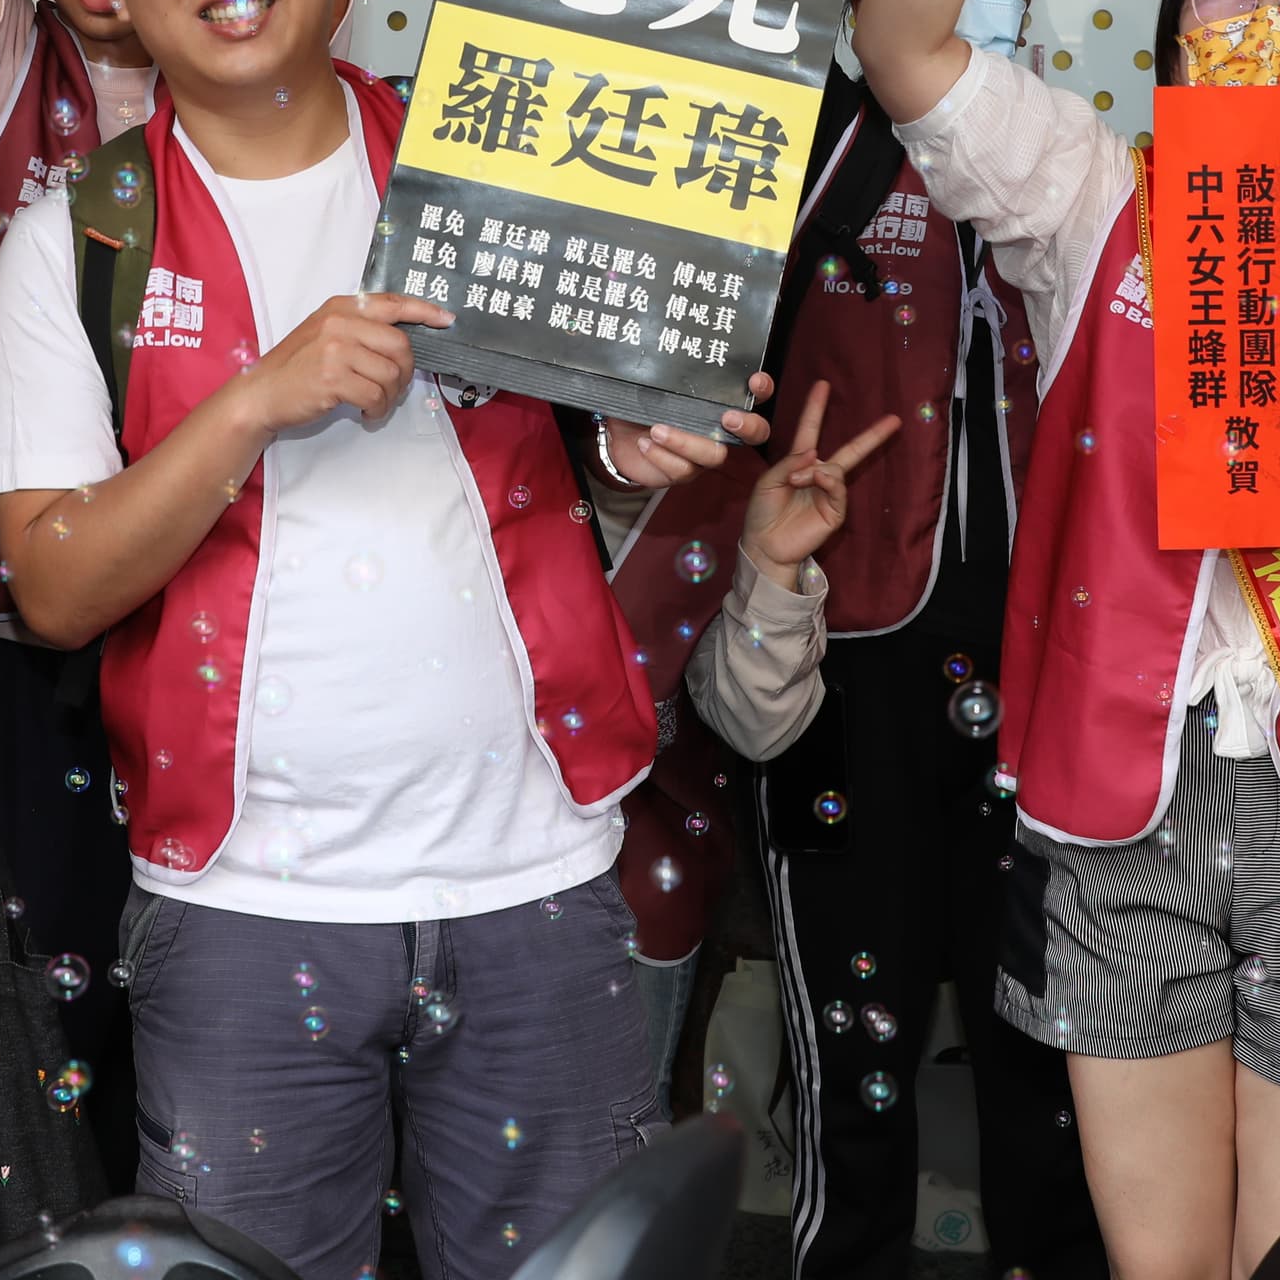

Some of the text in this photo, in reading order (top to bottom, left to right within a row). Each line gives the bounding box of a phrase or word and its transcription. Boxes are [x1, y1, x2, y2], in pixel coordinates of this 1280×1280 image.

[431, 41, 791, 212] 羅廷瑋
[145, 267, 203, 304] 東南
[410, 236, 737, 335] 罷免 廖偉翔 就是罷免 傅崐萁
[419, 203, 745, 302] 罷免 羅廷瑋 就是罷免 傅崐萁
[860, 242, 921, 257] at_low
[1186, 164, 1228, 409] 中六女王蜂群
[1236, 163, 1277, 409] 敲羅行動團隊
[137, 296, 204, 332] 行動
[403, 269, 730, 369] 罷免 黃健豪 就是罷免 傅崐萁
[1225, 416, 1259, 495] 敬賀
